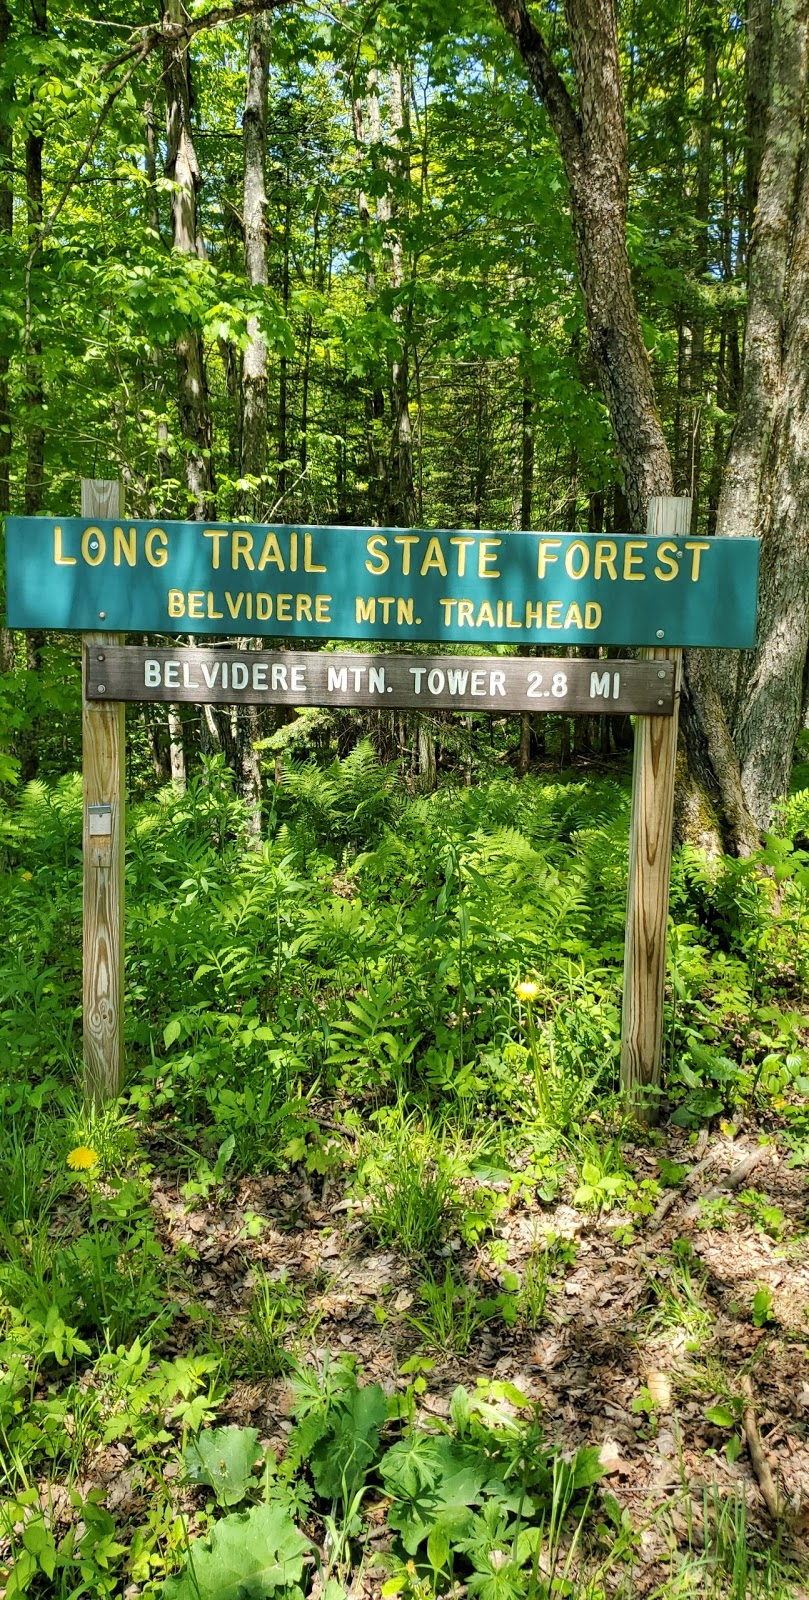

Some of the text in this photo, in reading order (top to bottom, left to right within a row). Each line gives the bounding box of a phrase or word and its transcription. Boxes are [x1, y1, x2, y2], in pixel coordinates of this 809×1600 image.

[53, 526, 710, 582] LONG TRAIL STATE FOREST
[168, 589, 603, 630] BELVIDERE MTN. TRAILHEAD
[144, 659, 621, 700] BELVIDERE MTN. TOWER 2.8 MI
